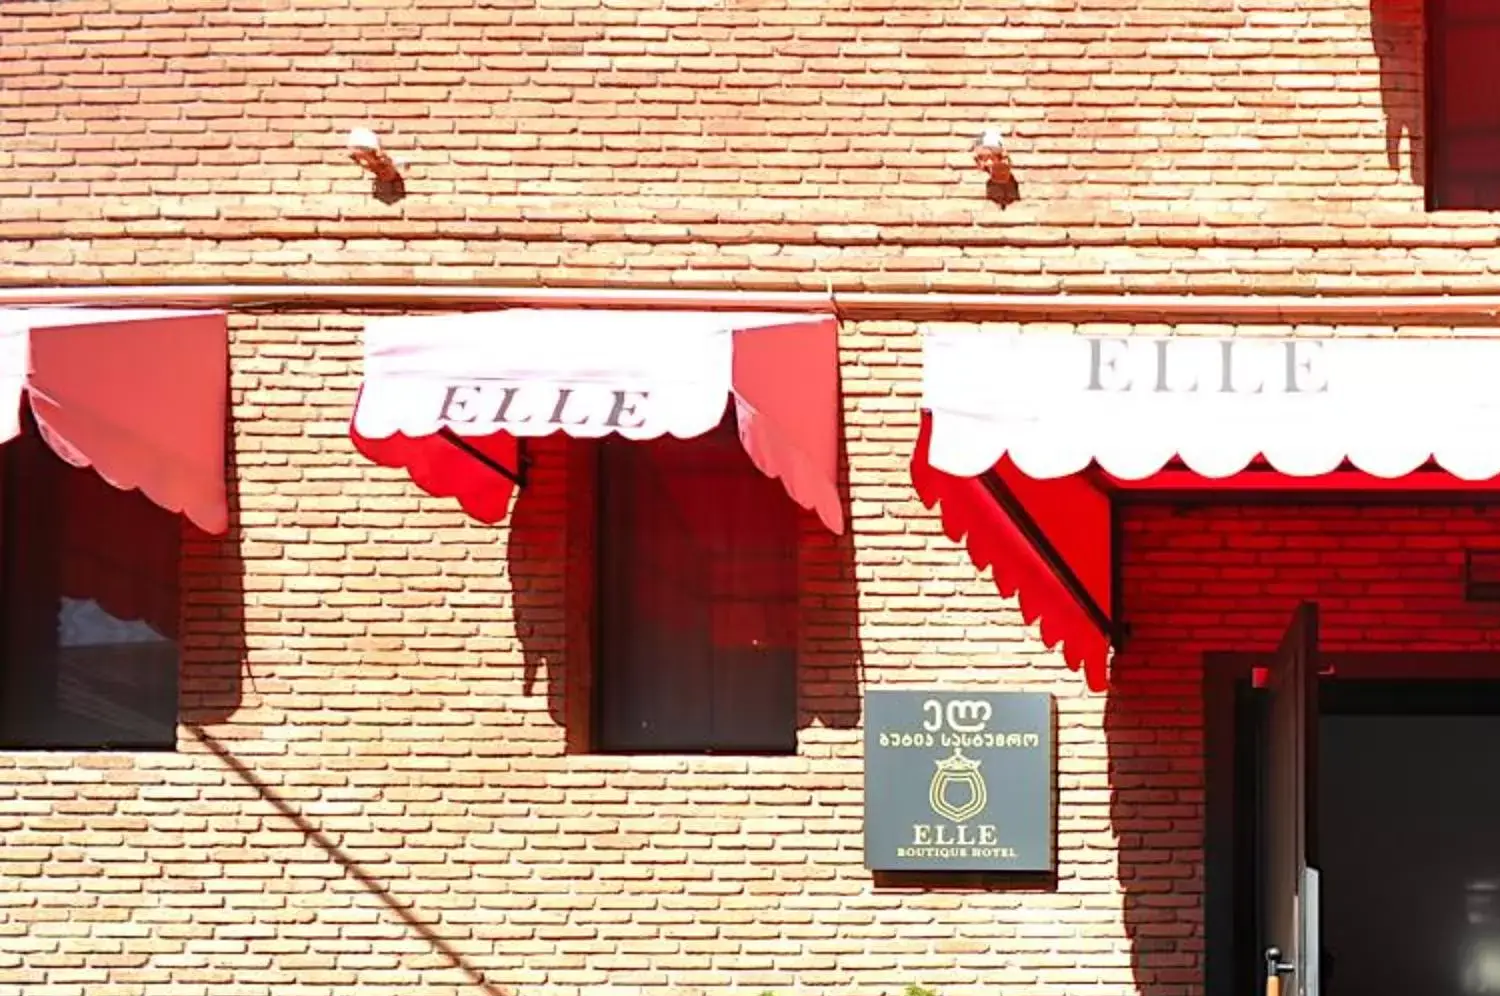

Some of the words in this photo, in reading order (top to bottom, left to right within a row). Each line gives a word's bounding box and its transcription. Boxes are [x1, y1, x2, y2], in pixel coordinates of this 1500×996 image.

[1083, 338, 1329, 393] ELLE
[437, 385, 650, 428] ELLE
[912, 824, 998, 845] ELLE
[896, 847, 968, 858] BOUTIQUE
[971, 847, 1018, 858] HOTEL
